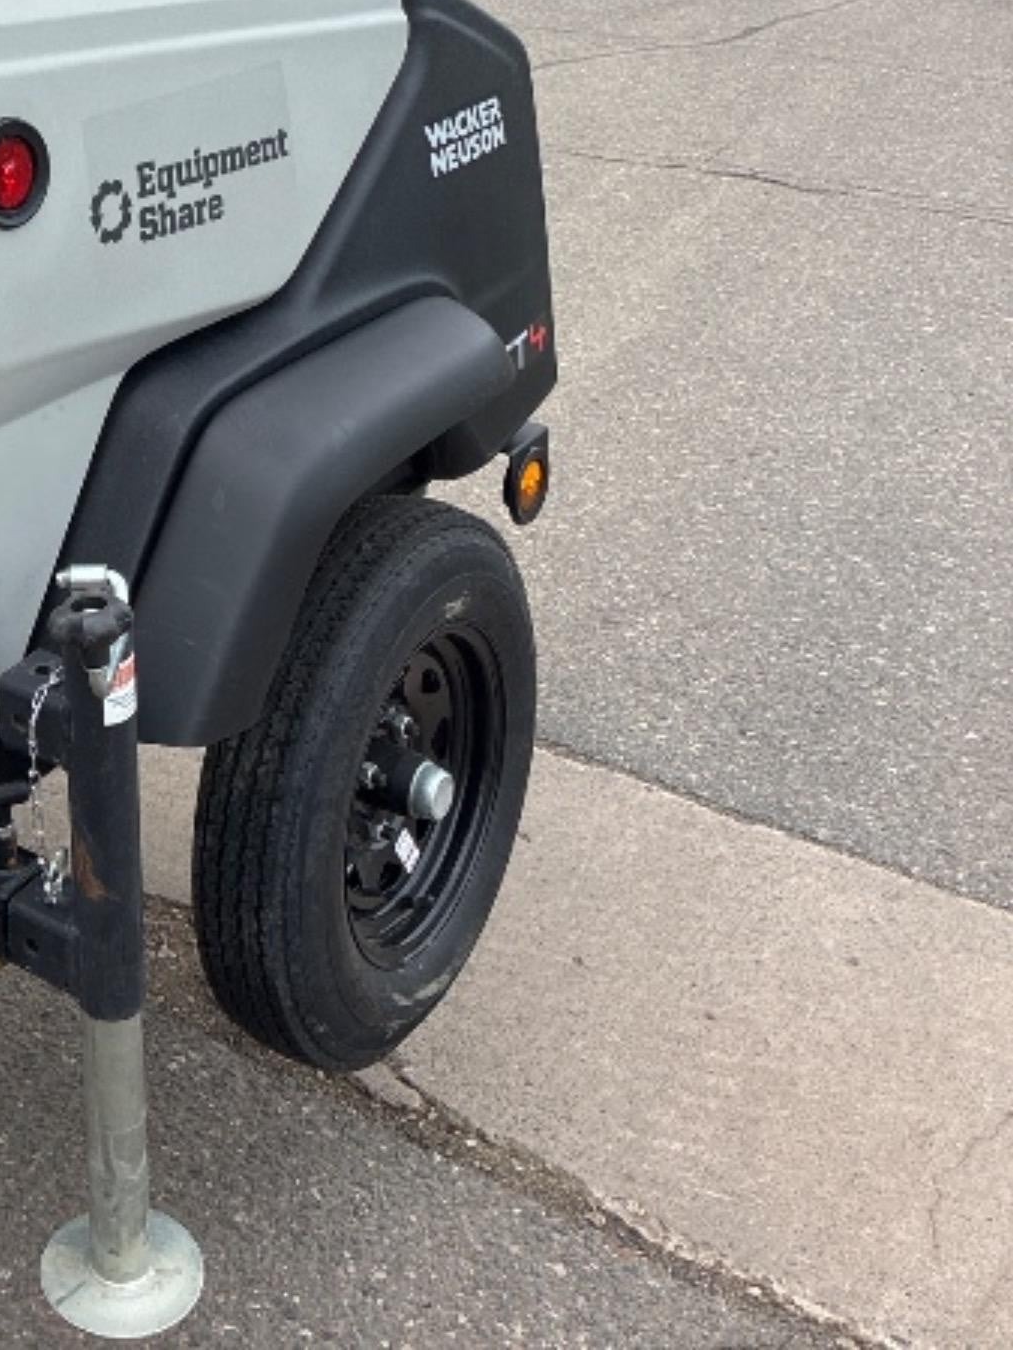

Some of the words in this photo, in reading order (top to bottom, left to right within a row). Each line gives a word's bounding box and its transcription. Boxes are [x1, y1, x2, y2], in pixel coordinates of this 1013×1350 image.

[424, 96, 502, 148] WACKER
[430, 121, 507, 177] NEUSON
[136, 128, 289, 199] Equipment
[139, 194, 225, 243] Share
